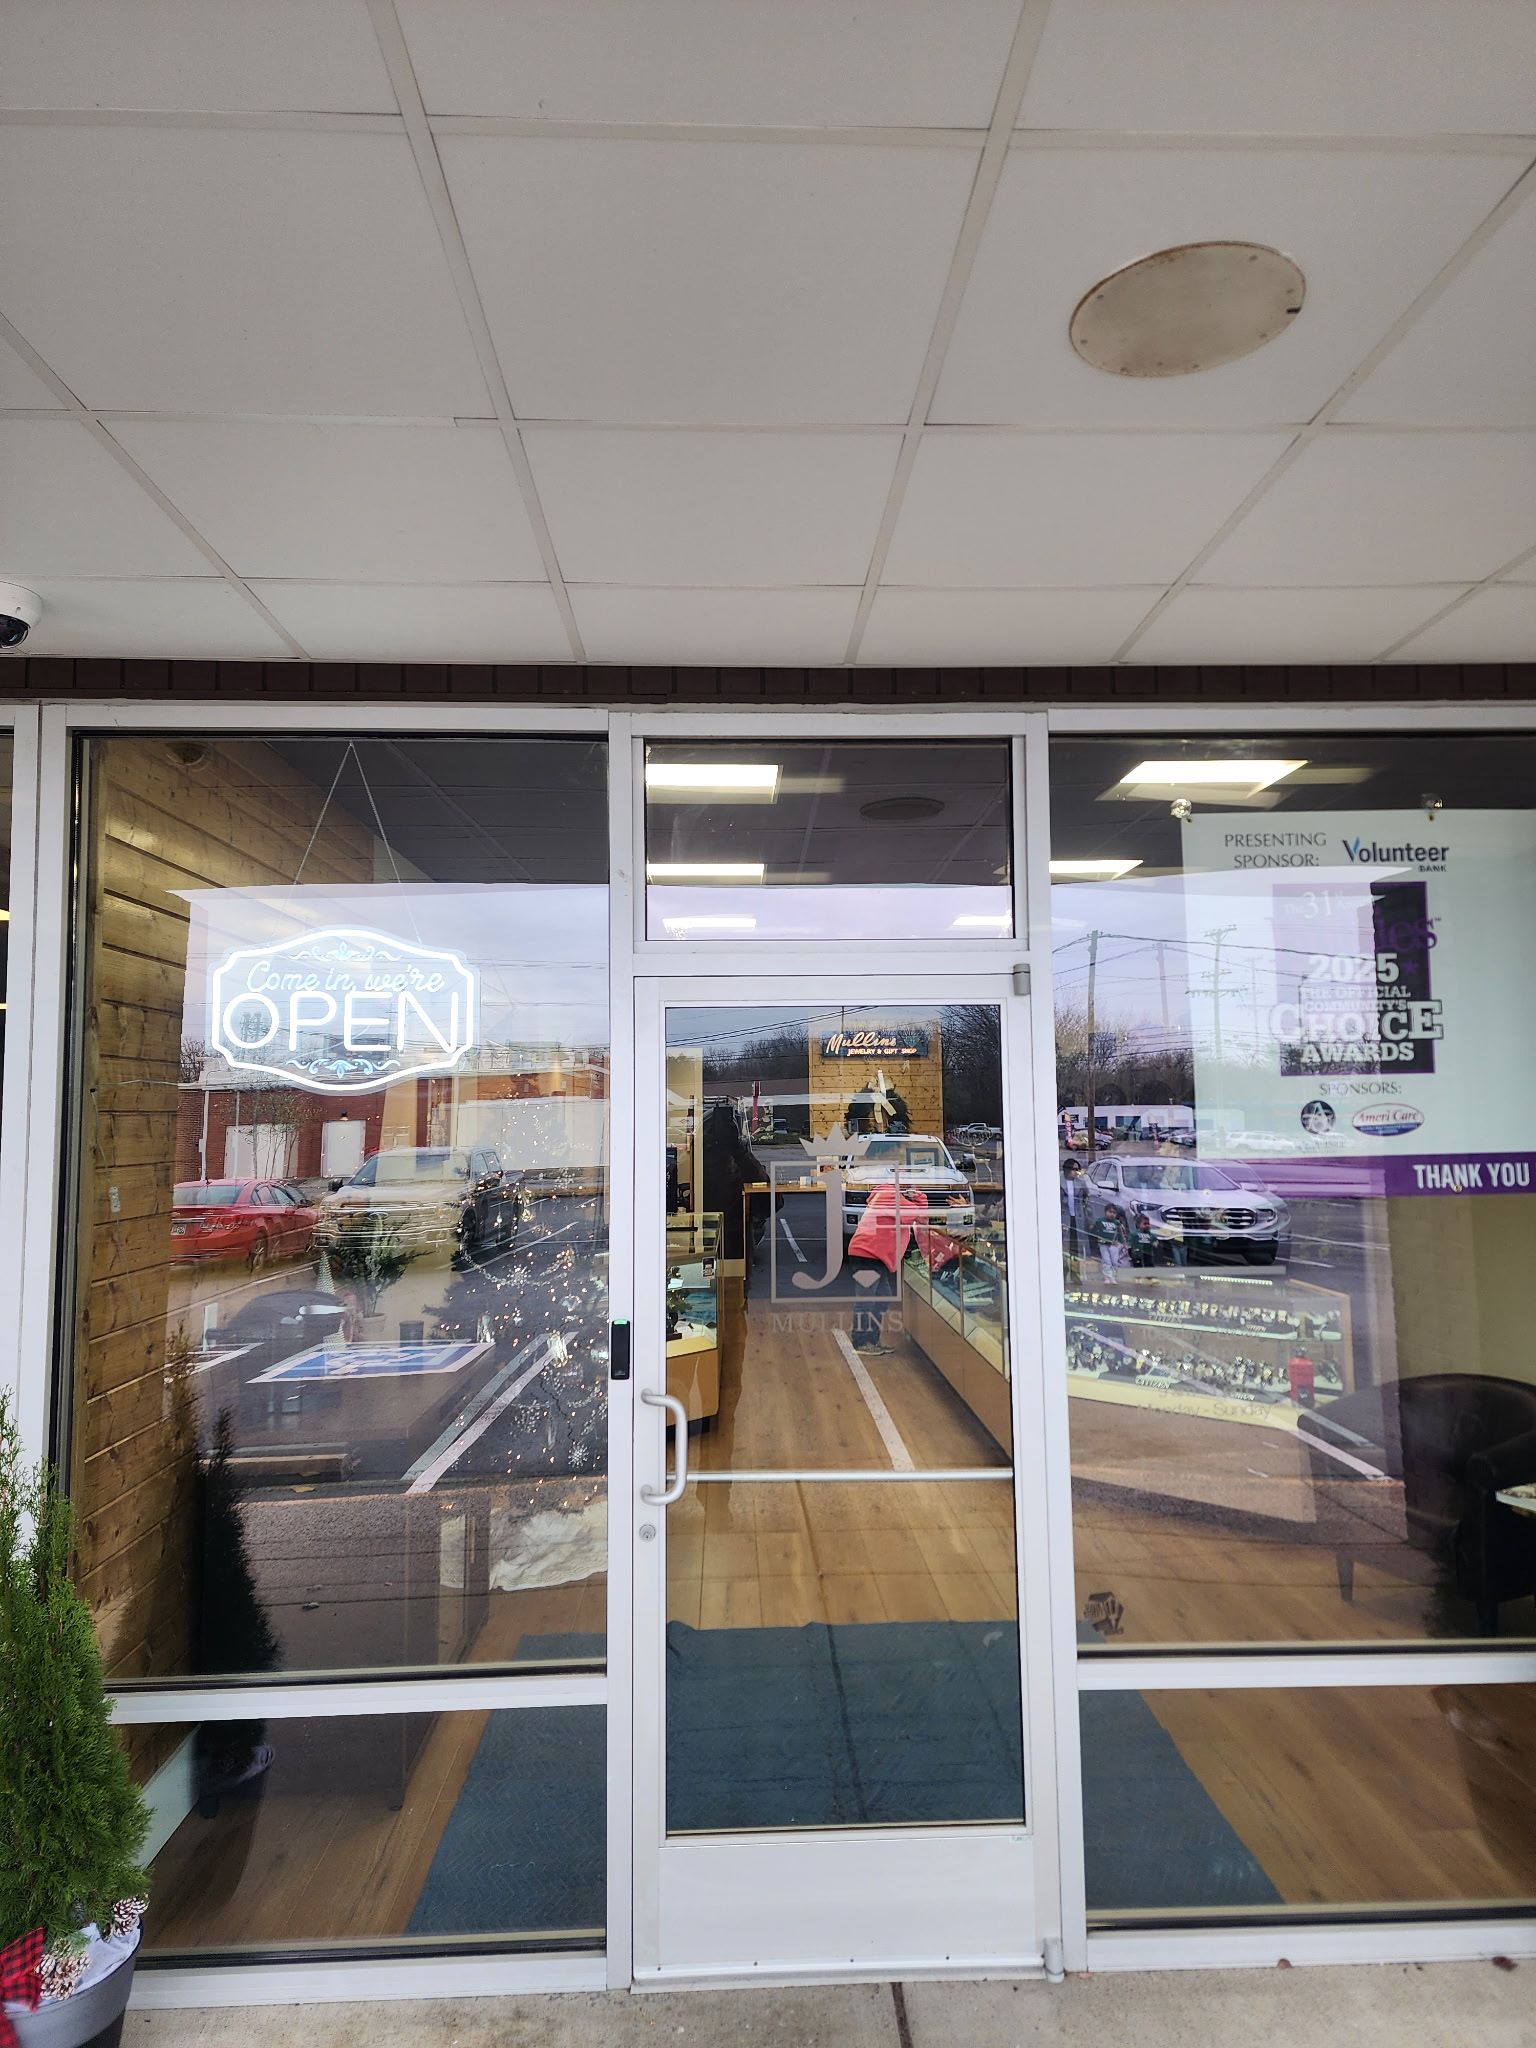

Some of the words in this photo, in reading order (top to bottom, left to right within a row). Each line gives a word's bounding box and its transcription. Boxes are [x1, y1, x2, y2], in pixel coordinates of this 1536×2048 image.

[1224, 832, 1327, 848] PRESENTING
[1342, 836, 1450, 863] Volunteer
[1233, 853, 1320, 868] SPONSOR:
[1417, 864, 1447, 872] BANK
[246, 961, 321, 993] Come
[364, 963, 446, 993] we're
[1308, 953, 1400, 984] 2025
[222, 990, 459, 1054] OPEN
[1269, 999, 1444, 1041] CHOICE
[827, 1032, 896, 1054] Mullins
[847, 1048, 876, 1056] JEWELRY
[1301, 1042, 1415, 1062] AWARDS
[1319, 1082, 1402, 1095] SPONSORS:
[1412, 1163, 1484, 1190] THANK
[1486, 1162, 1531, 1188] YOU
[770, 1311, 904, 1333] MULLINS
